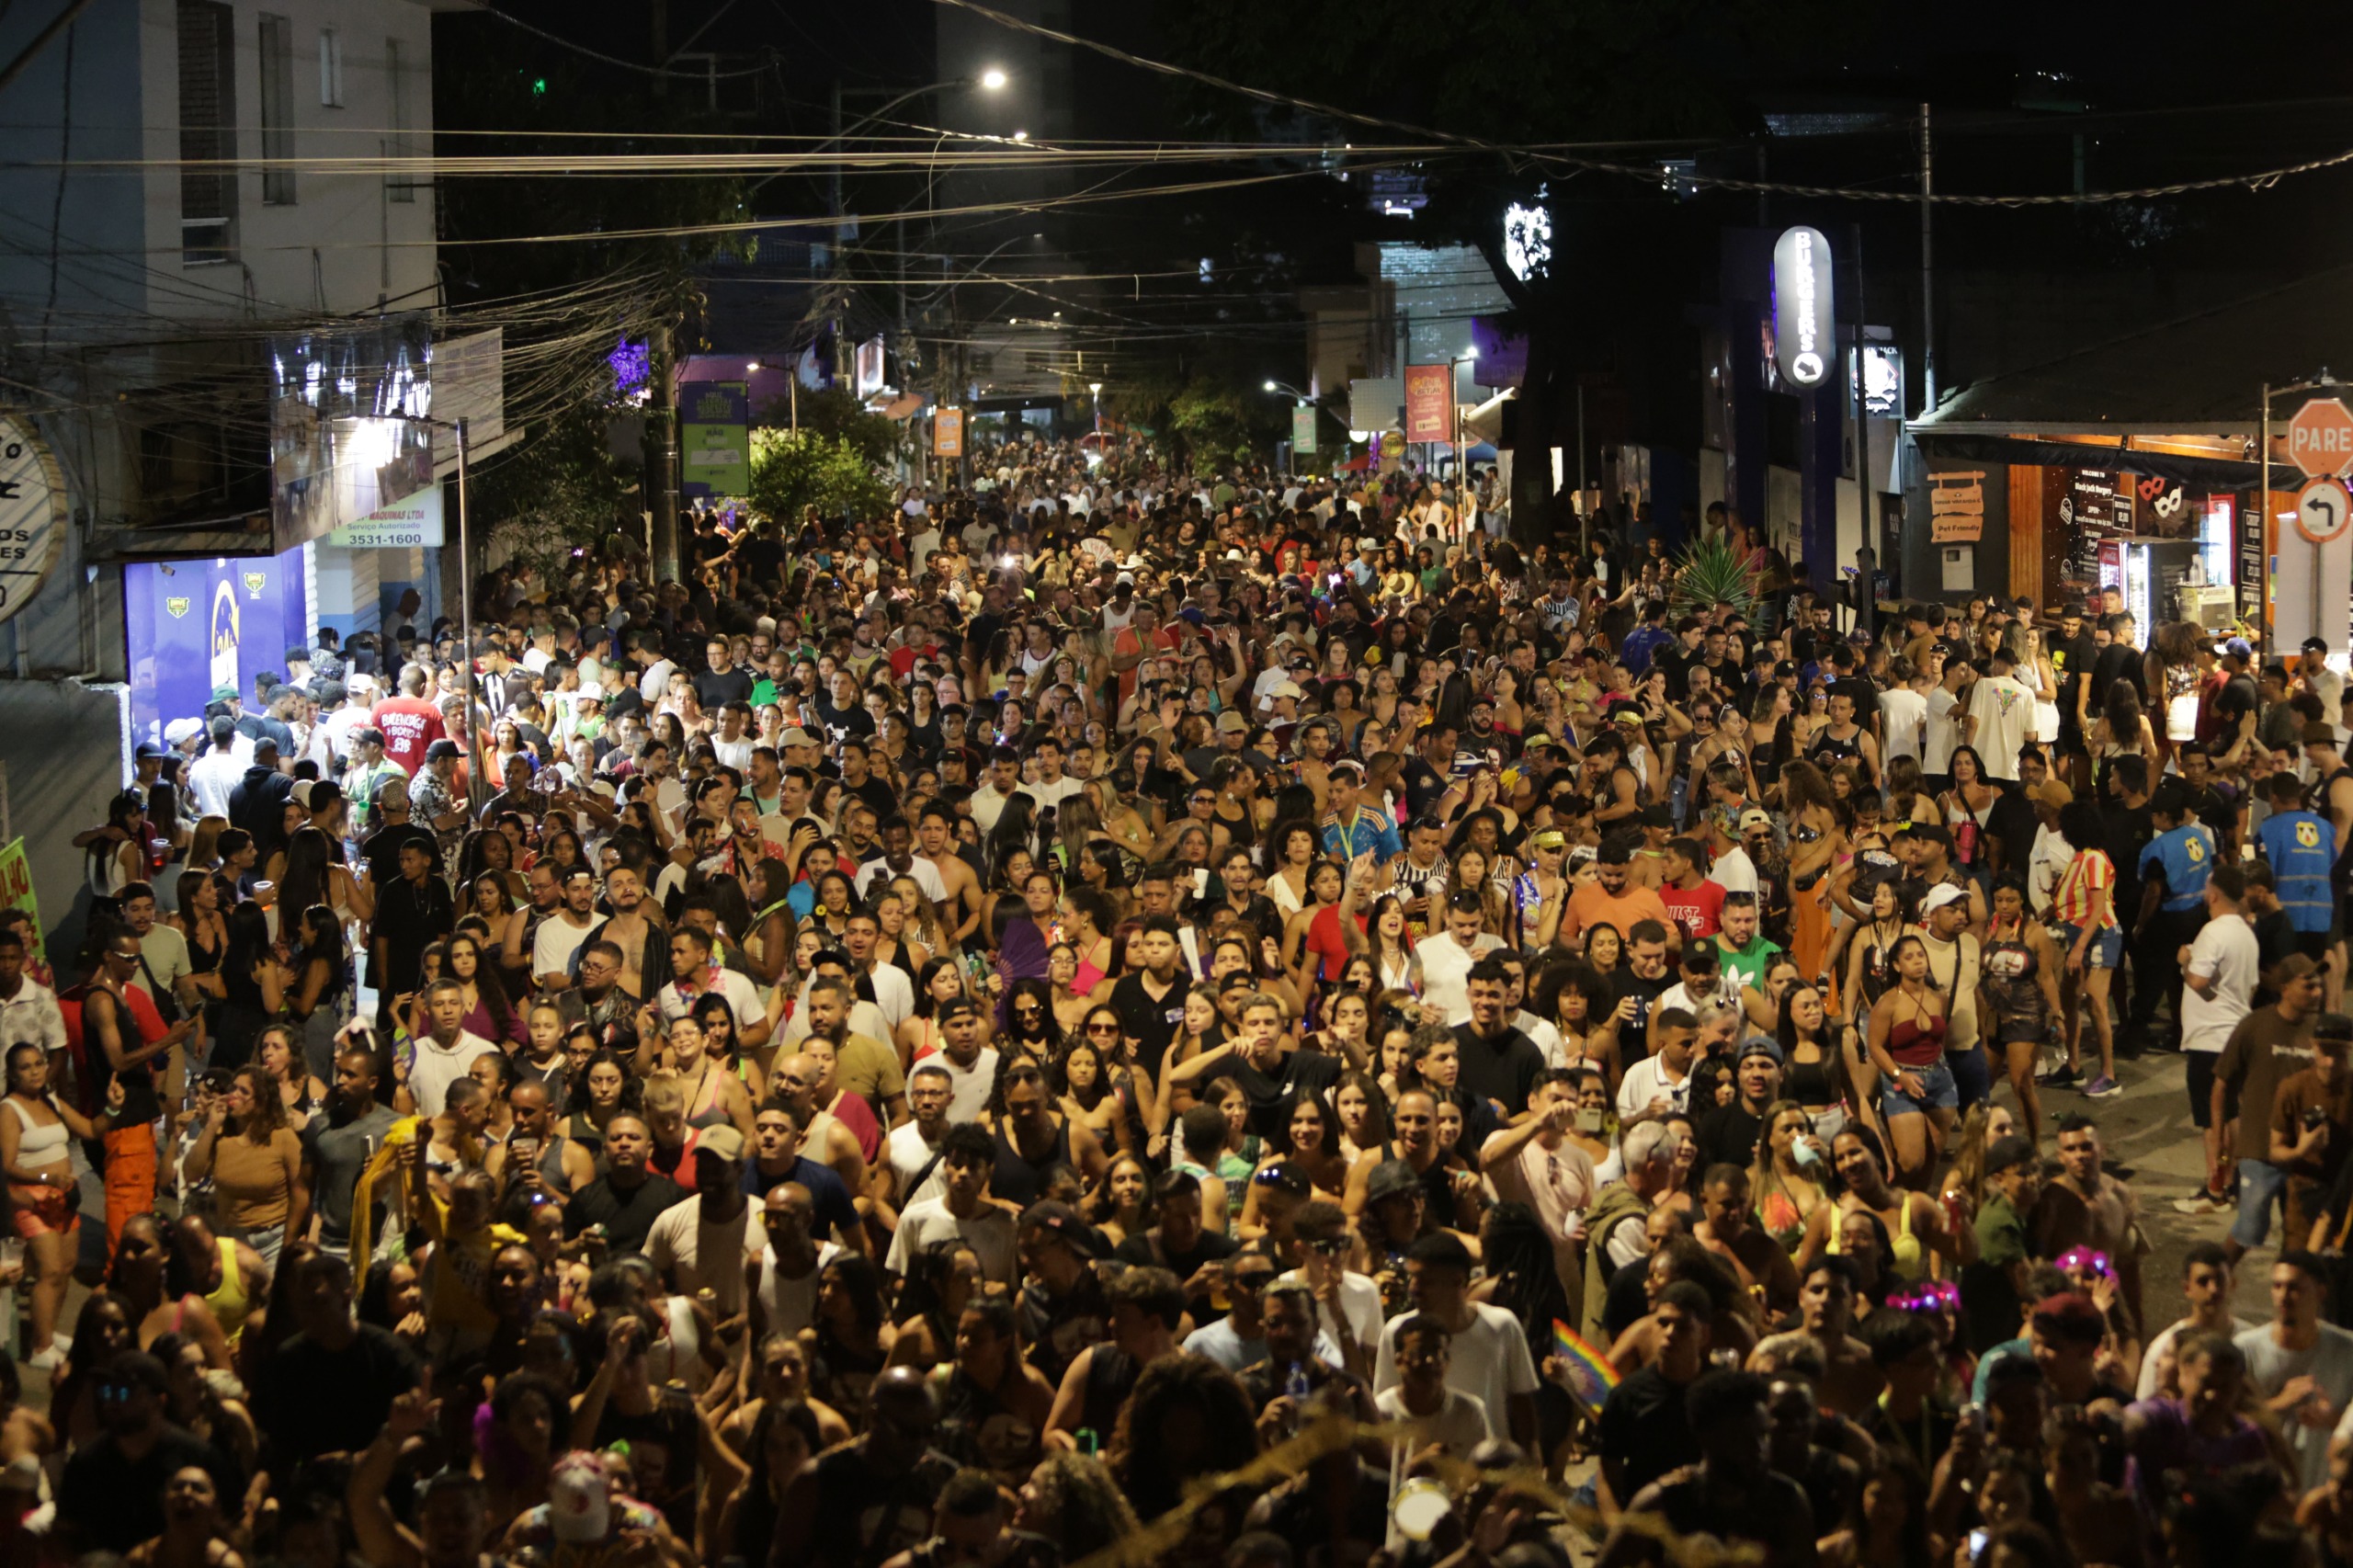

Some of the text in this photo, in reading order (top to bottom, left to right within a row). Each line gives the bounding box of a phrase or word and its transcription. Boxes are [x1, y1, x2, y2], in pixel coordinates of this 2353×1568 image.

[1795, 232, 1816, 352] BURGERS
[2295, 426, 2351, 452] PARE
[406, 509, 425, 519] LTDA
[347, 521, 421, 531] Serviço Autorizado
[349, 534, 422, 545] 3531-1600
